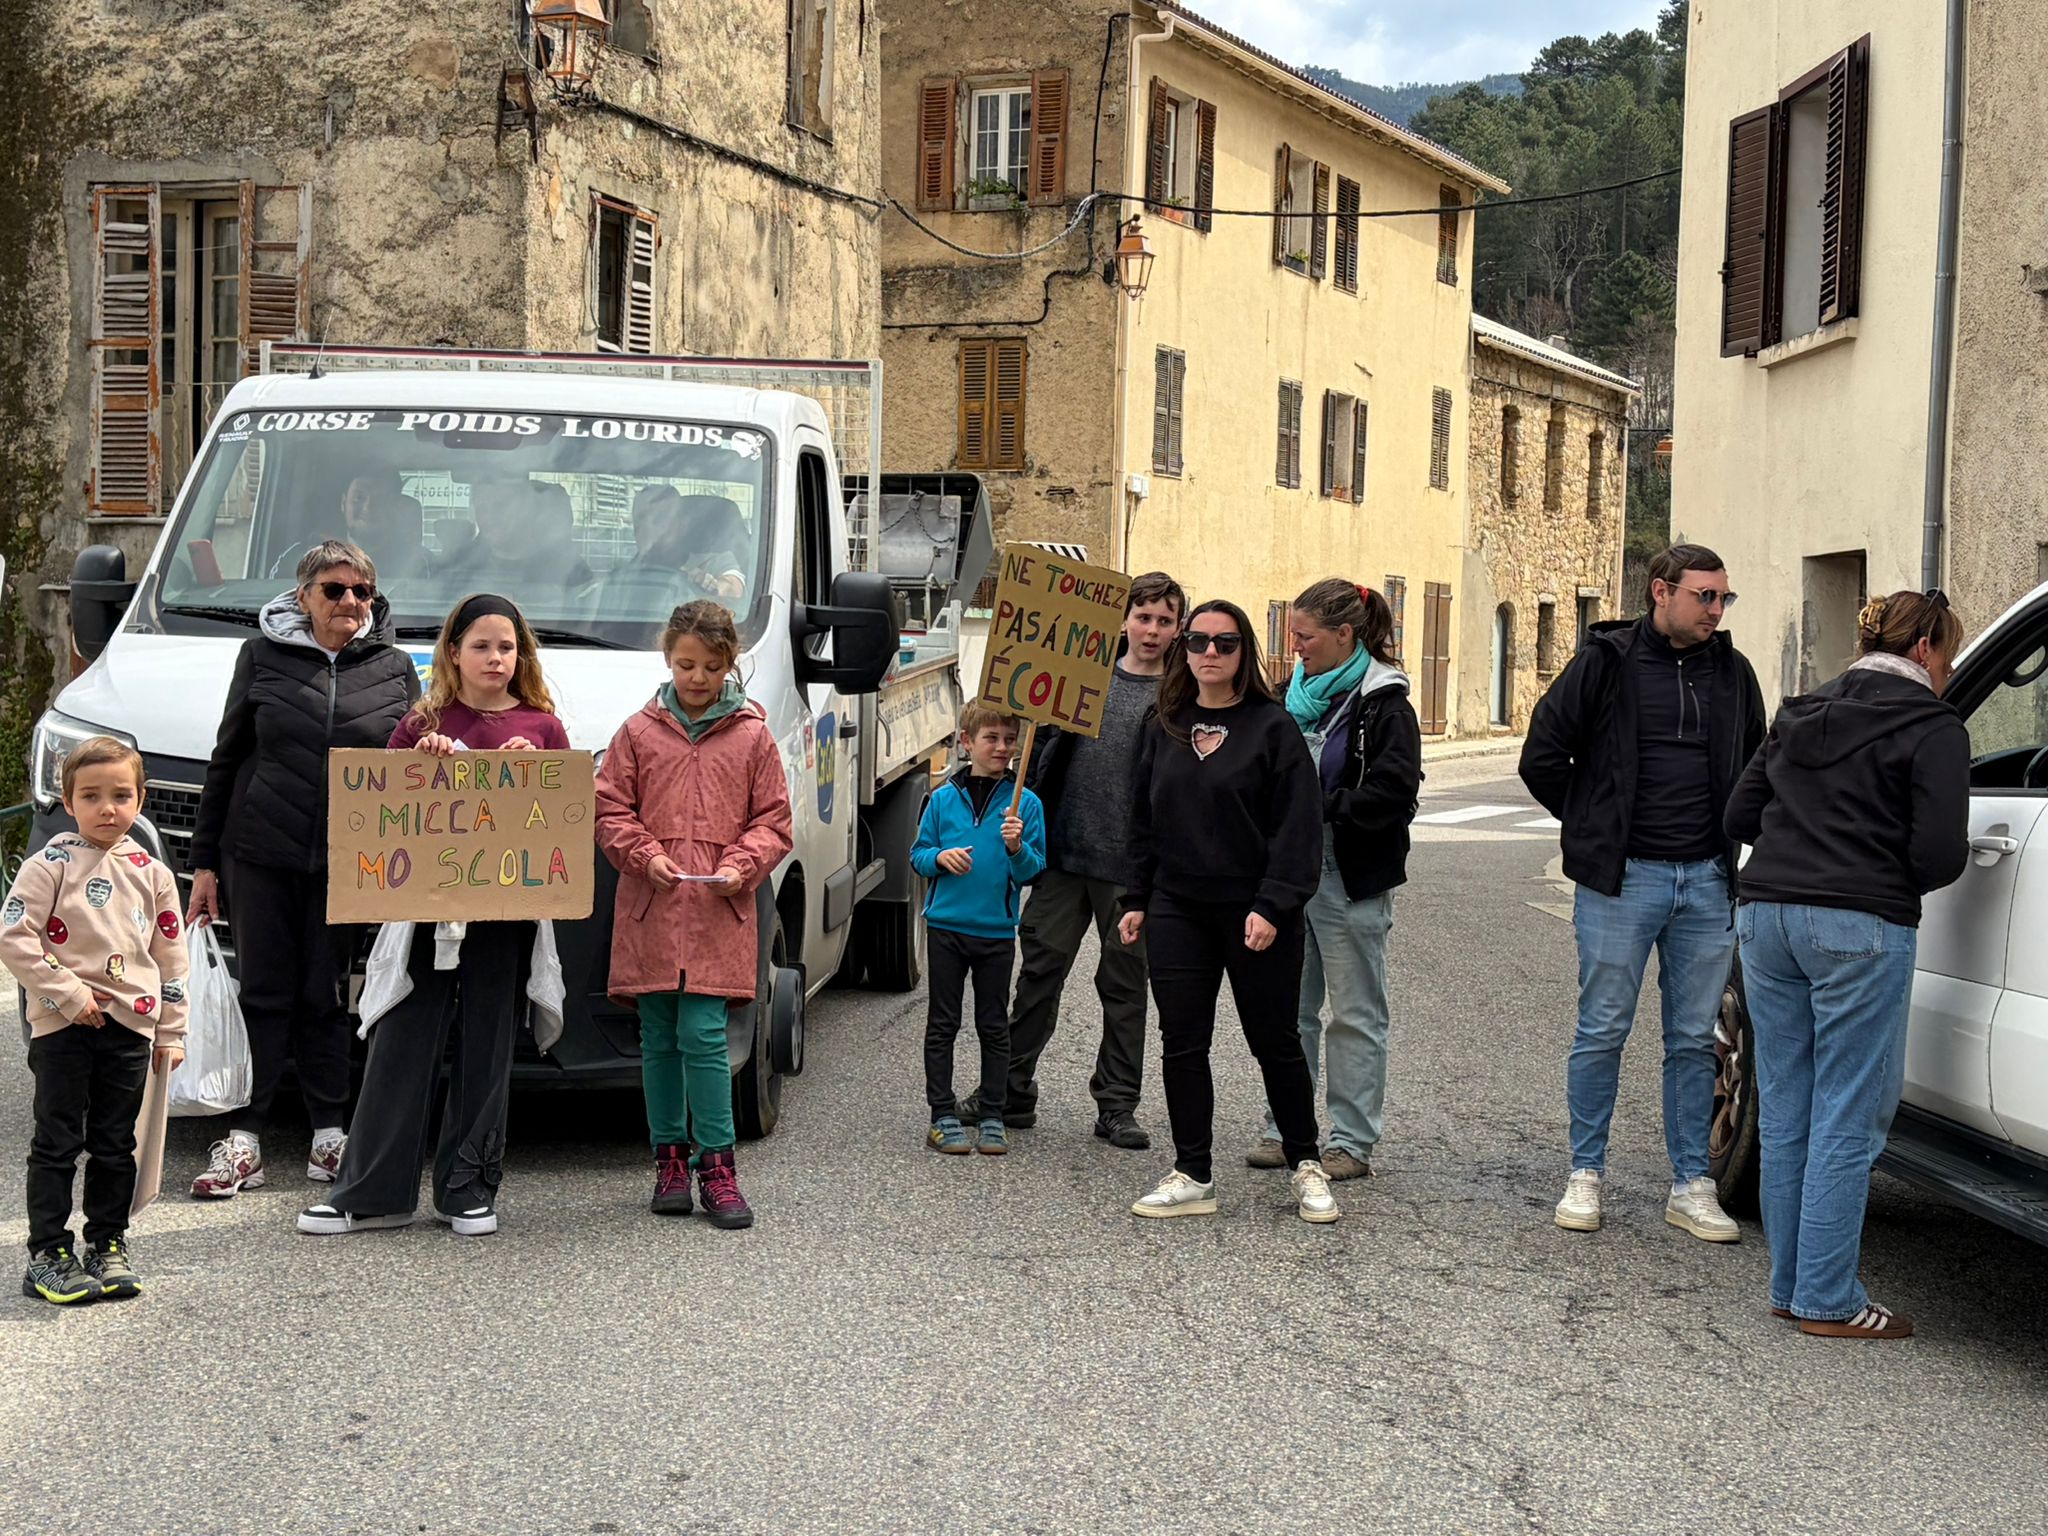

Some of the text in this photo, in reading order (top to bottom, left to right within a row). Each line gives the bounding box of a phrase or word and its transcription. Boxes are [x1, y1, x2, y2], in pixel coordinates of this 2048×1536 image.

[257, 412, 724, 447] CORSE POIDS LOURDS
[1004, 553, 1129, 610] NE TOUCHEZ
[994, 600, 1041, 643] PAS
[1063, 622, 1115, 668] MON
[983, 645, 1101, 729] ÉCOLE
[343, 758, 565, 792] UN SARRATE
[378, 798, 549, 838] MICCA A
[356, 846, 569, 890] MO SCOLA
